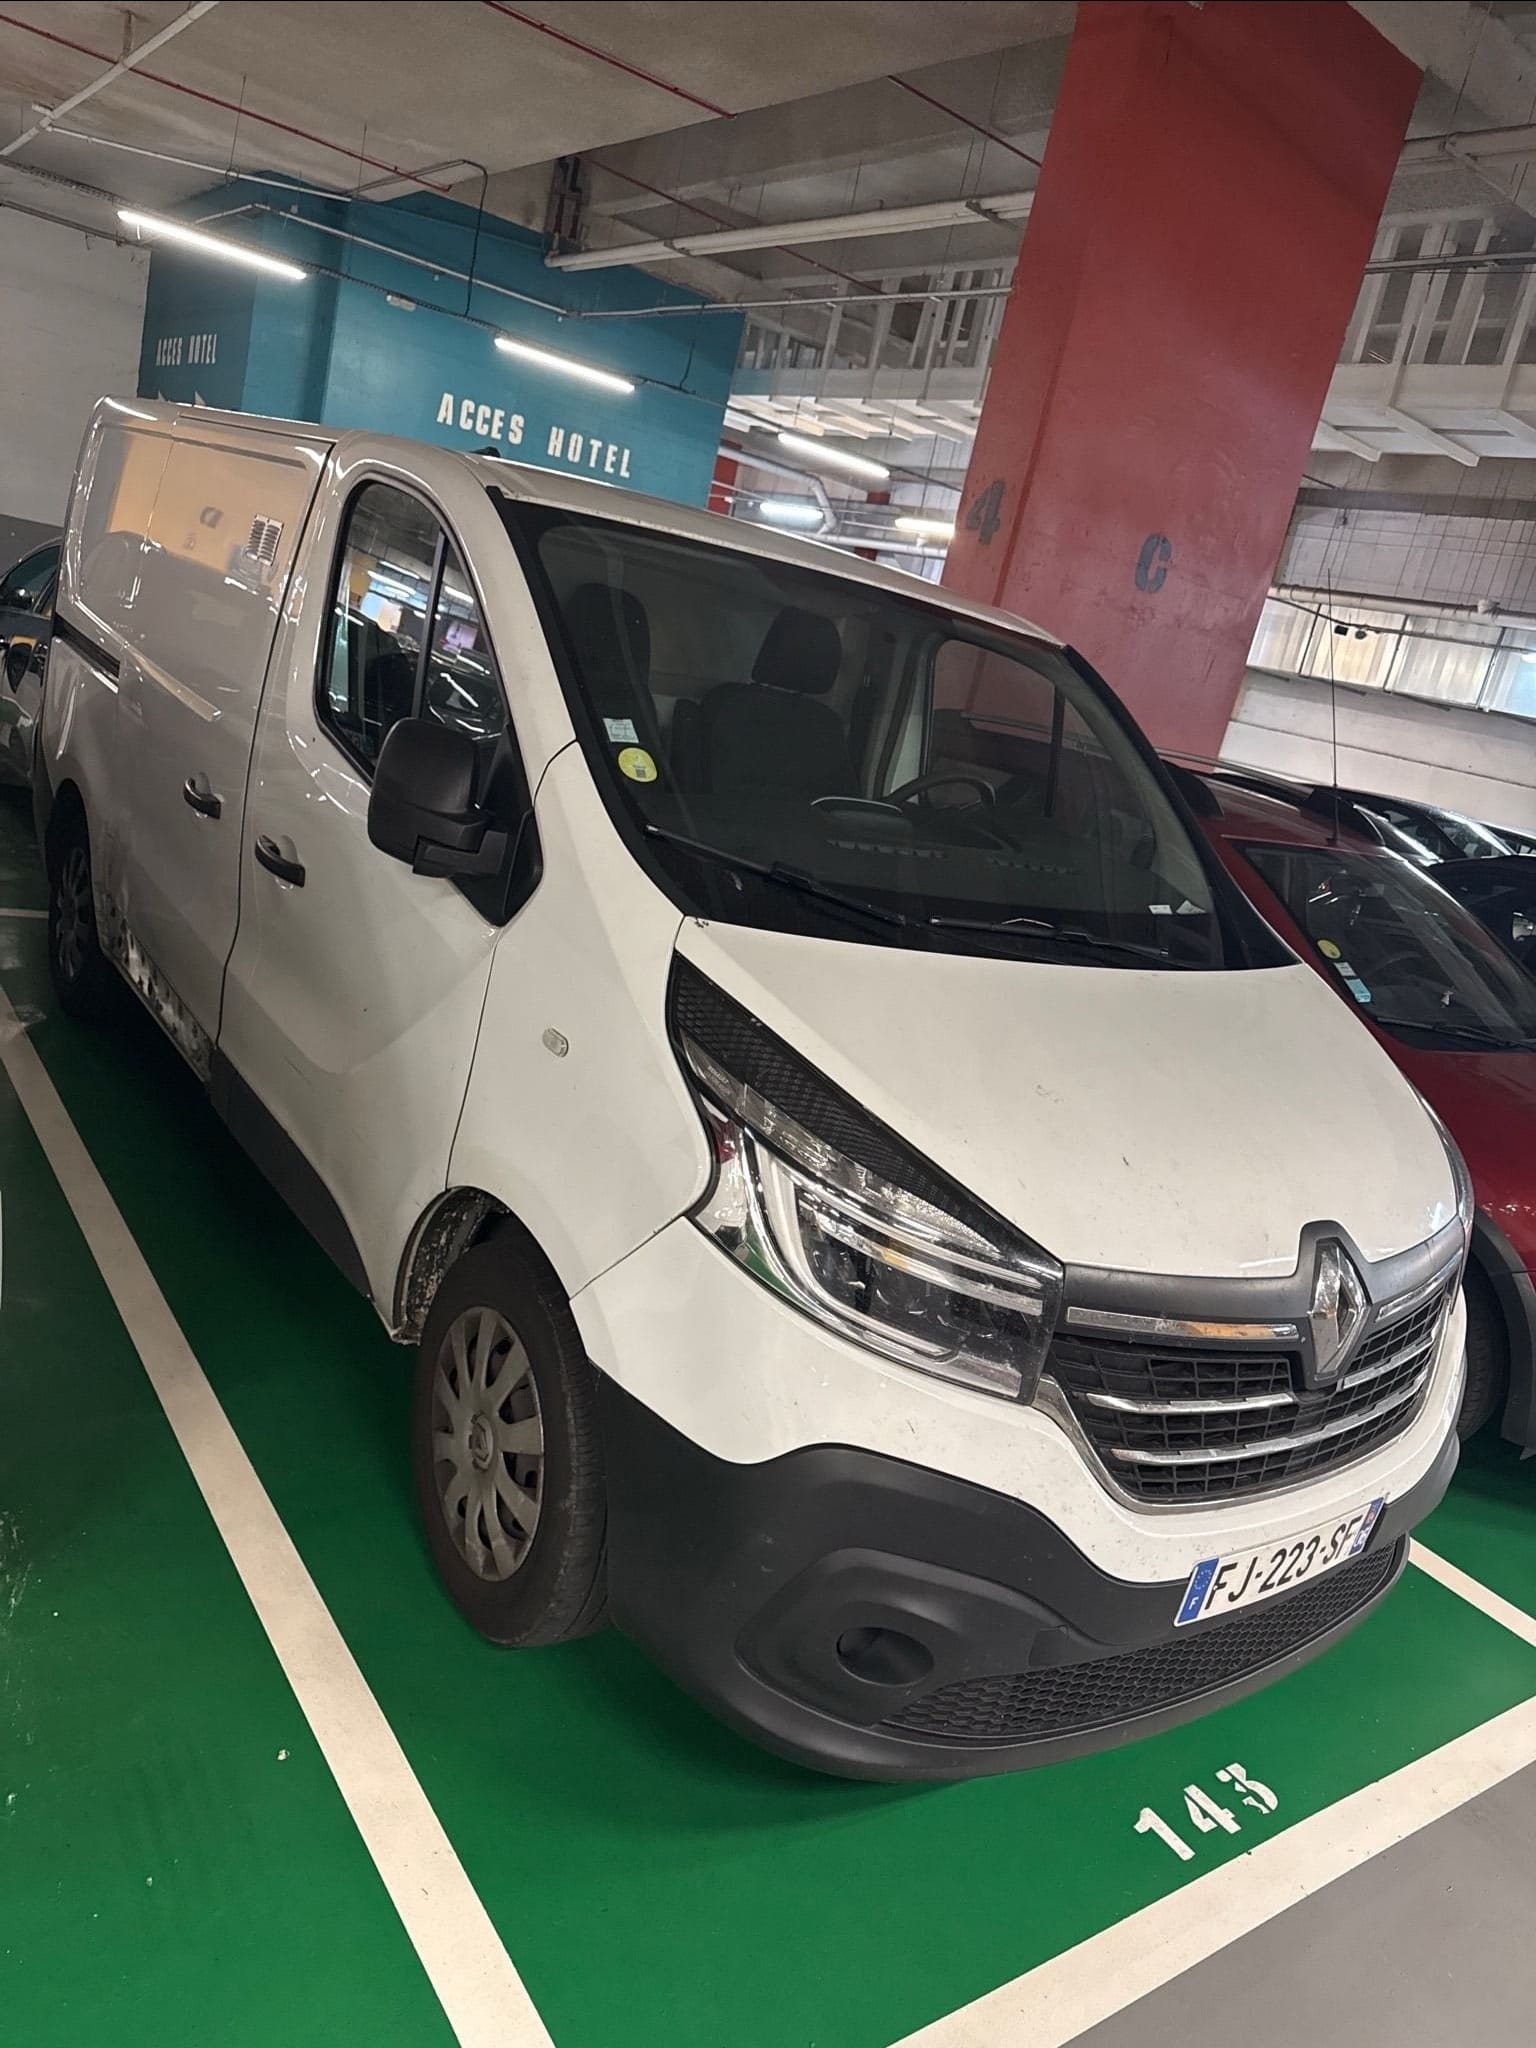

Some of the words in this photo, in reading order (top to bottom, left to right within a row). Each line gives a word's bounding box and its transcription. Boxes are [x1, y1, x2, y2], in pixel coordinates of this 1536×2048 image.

[155, 337, 183, 366] ACCES
[188, 333, 217, 365] HOTEL
[436, 392, 525, 445] ACCES
[547, 426, 630, 479] HOTEL
[966, 480, 1005, 545] 4
[1135, 533, 1171, 594] C
[1203, 1514, 1364, 1611] FJ-223-SF
[1133, 1762, 1278, 1861] 143
